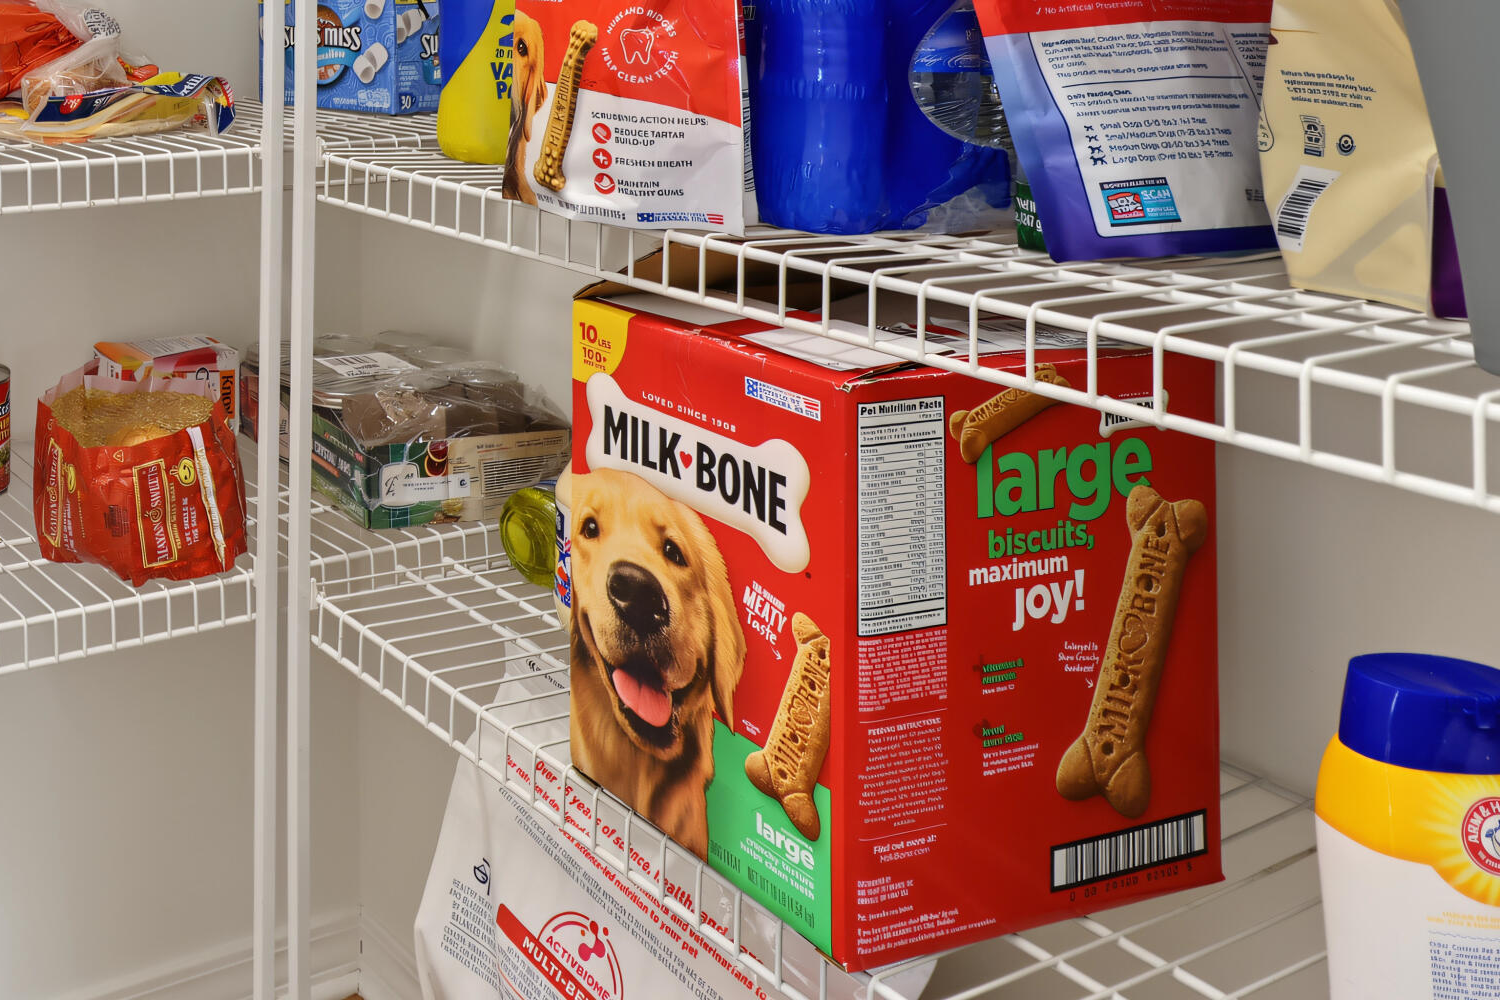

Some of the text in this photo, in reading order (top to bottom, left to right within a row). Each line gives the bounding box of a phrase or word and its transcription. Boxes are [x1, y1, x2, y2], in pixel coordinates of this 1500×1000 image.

[624, 6, 645, 16] AND
[324, 26, 362, 51] MISS
[617, 70, 654, 84] CLEAN
[614, 127, 685, 139] REDUCE TARTAR
[639, 116, 675, 125] ACTION
[579, 322, 598, 344] 10
[642, 390, 673, 409] LOVED
[677, 404, 707, 422] SINCE
[860, 400, 943, 416] Pet Nutrition Facts
[603, 404, 682, 480] MILK
[696, 441, 787, 536] BONE
[976, 437, 1153, 520] large
[988, 520, 1095, 559] biscuits,
[968, 555, 1068, 586] maximum
[742, 586, 787, 632] MEATY
[745, 606, 778, 645] Taste
[601, 824, 616, 841] of
[1467, 806, 1482, 844] ARM
[755, 811, 815, 871] large
[613, 878, 649, 914] nutrition
[659, 919, 682, 942] your
[682, 940, 699, 959] pet
